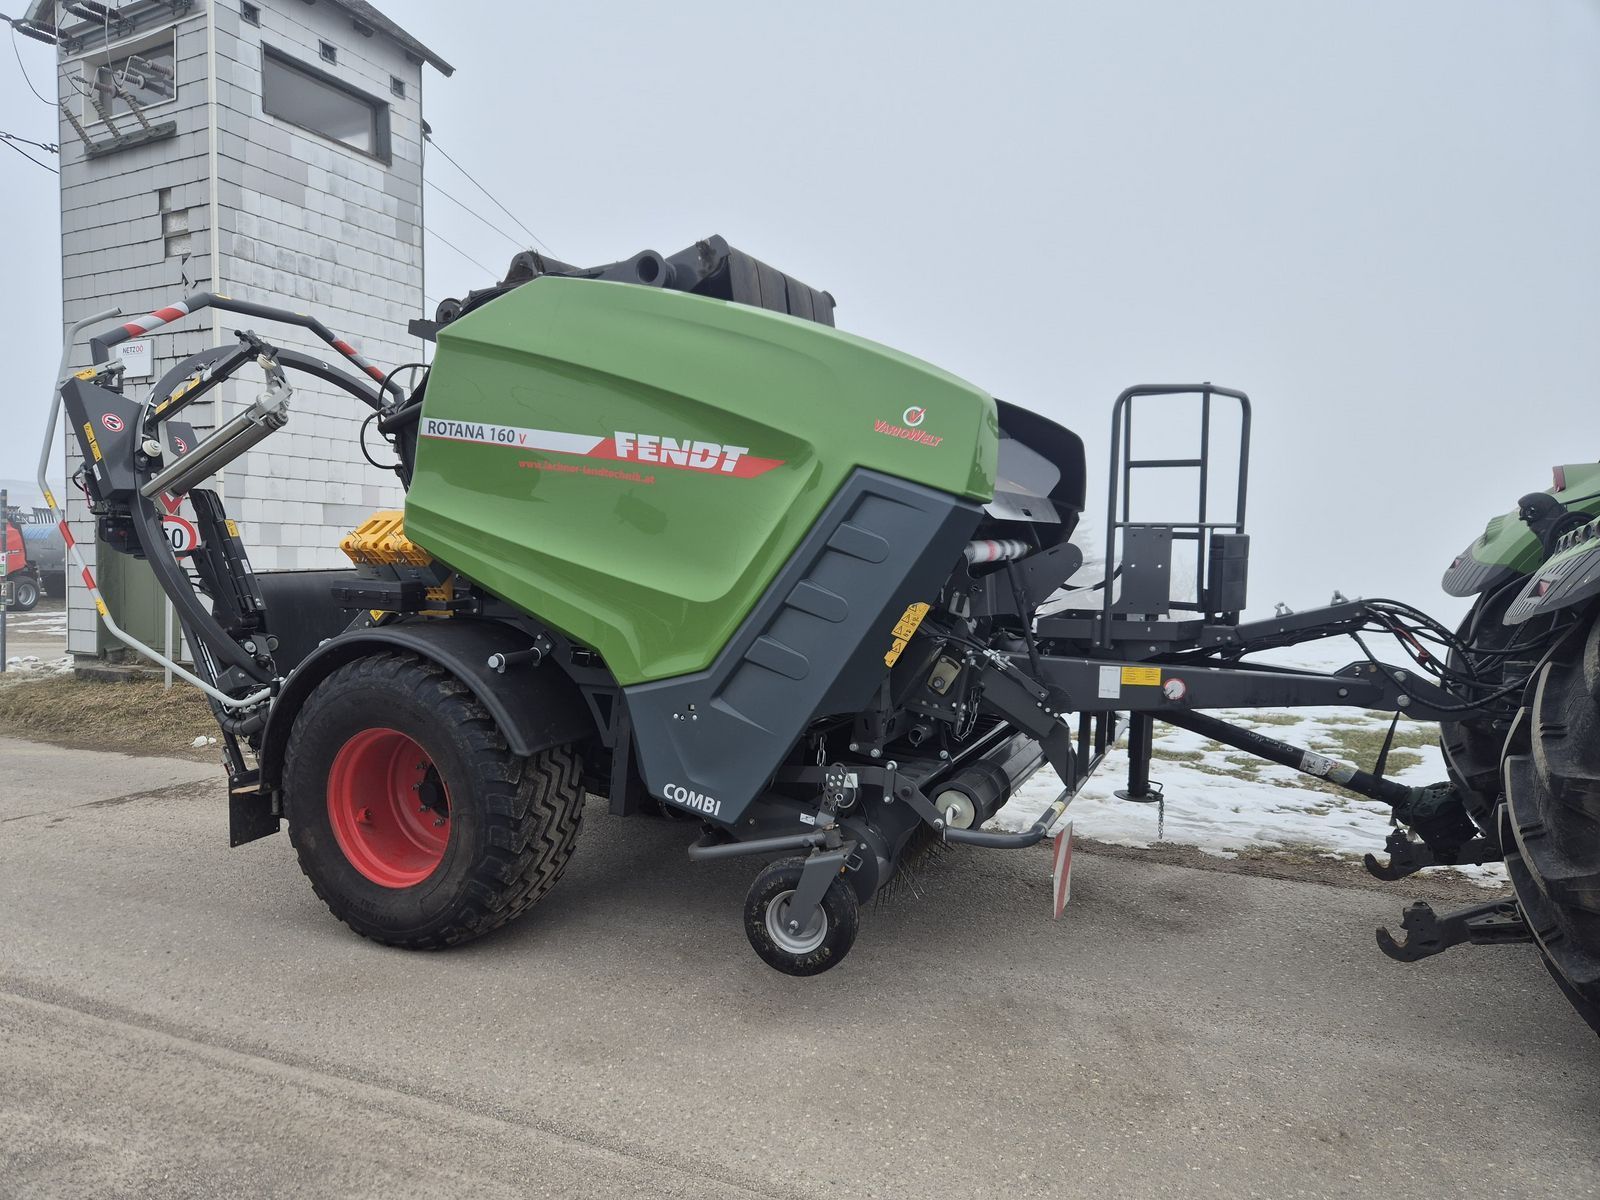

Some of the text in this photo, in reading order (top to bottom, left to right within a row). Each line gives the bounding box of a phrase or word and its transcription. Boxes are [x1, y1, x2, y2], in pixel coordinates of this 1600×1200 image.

[428, 420, 527, 445] ROTANA 160 V
[614, 431, 749, 473] FENDT
[663, 783, 721, 816] COMBI
